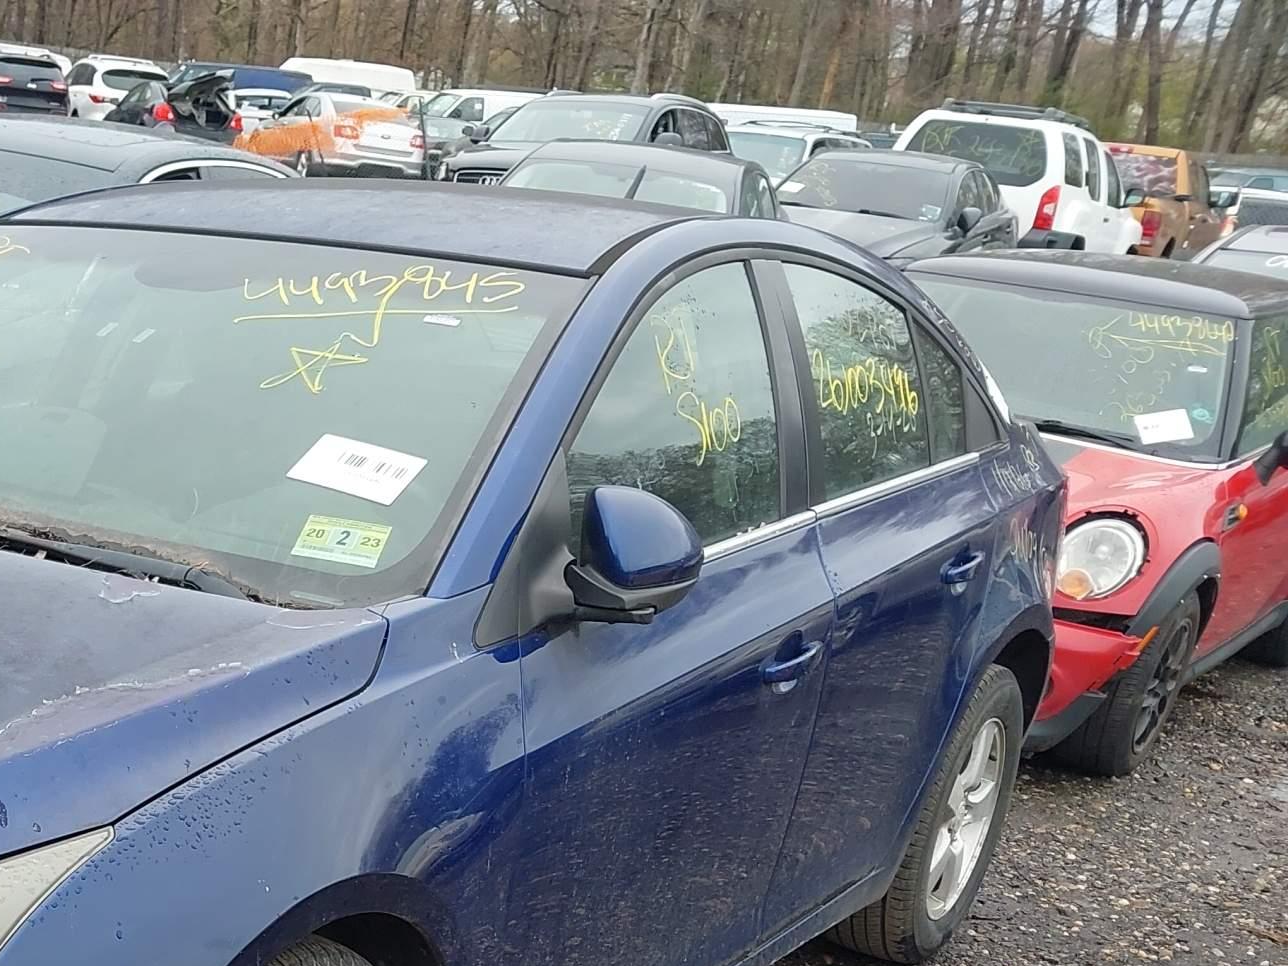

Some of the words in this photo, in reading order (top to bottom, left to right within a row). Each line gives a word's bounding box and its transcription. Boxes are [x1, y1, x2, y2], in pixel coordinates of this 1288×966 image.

[306, 528, 325, 539] 20
[336, 530, 351, 546] 2
[360, 536, 381, 548] 23
